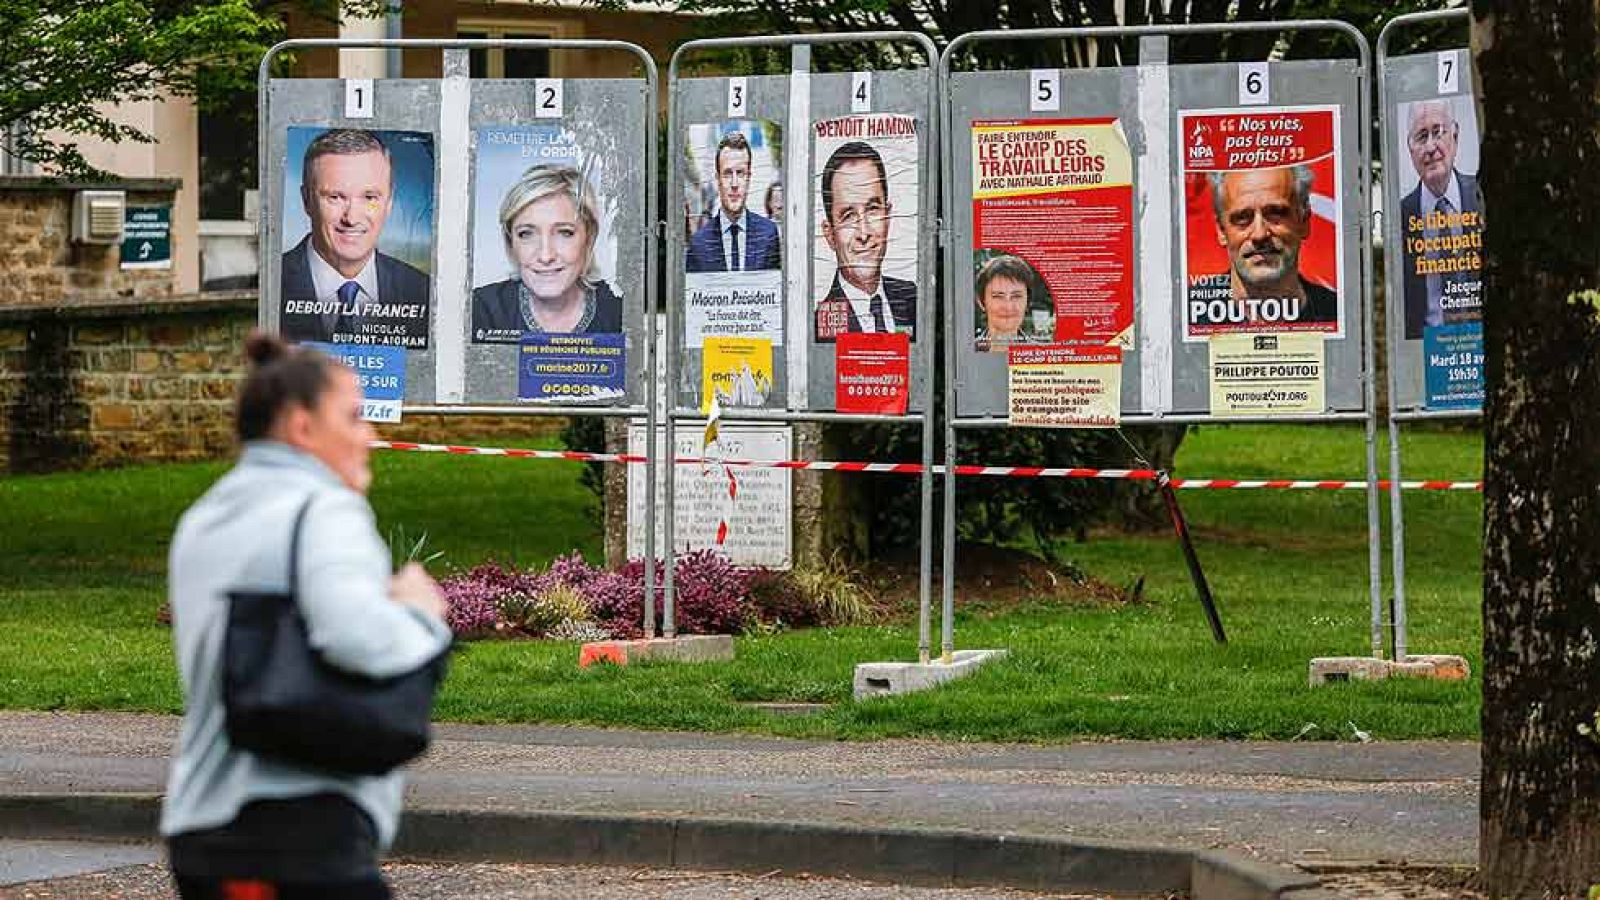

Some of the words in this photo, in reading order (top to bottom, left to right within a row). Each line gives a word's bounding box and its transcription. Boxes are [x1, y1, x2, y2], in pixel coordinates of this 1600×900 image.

[1443, 61, 1453, 83] 7
[1038, 79, 1052, 101] 5
[1246, 71, 1262, 94] 6
[354, 87, 363, 109] 1
[542, 87, 556, 109] 2
[732, 86, 742, 108] 3
[855, 79, 867, 103] 4
[1239, 117, 1266, 131] Nos
[1270, 115, 1303, 131] vies,
[978, 132, 1005, 143] FAIRE
[1007, 131, 1057, 142] ENTENDRE
[1225, 135, 1253, 152] pas
[1256, 132, 1293, 146] leurs
[978, 144, 998, 160] LE
[1002, 141, 1049, 159] CAMP
[1055, 139, 1087, 156] DES
[1189, 147, 1214, 158] NPA
[979, 155, 1105, 177] TRAVAILLEURS
[980, 177, 1007, 189] AVEC
[1007, 175, 1054, 188] NATHALIE
[1056, 173, 1103, 187] ARTHAUD
[1409, 215, 1424, 232] Se
[1189, 274, 1231, 288] VOTEZ
[691, 291, 729, 306] Macron
[1189, 288, 1234, 300] PHILIPPE
[285, 299, 342, 315] DEBOUT
[342, 303, 360, 316] LA
[1190, 298, 1299, 324] POUTOU
[362, 324, 406, 335] NICOLAS
[333, 332, 426, 347] DUPONT-AIGNAN
[358, 355, 385, 369] LES
[1459, 352, 1472, 365] 18
[536, 363, 609, 375] marine2017.fr
[1215, 366, 1266, 378] PHILIPPE
[1270, 364, 1319, 377] POUTOU
[371, 376, 398, 388] SUR
[1072, 396, 1090, 405] site
[1026, 406, 1077, 415] campagne
